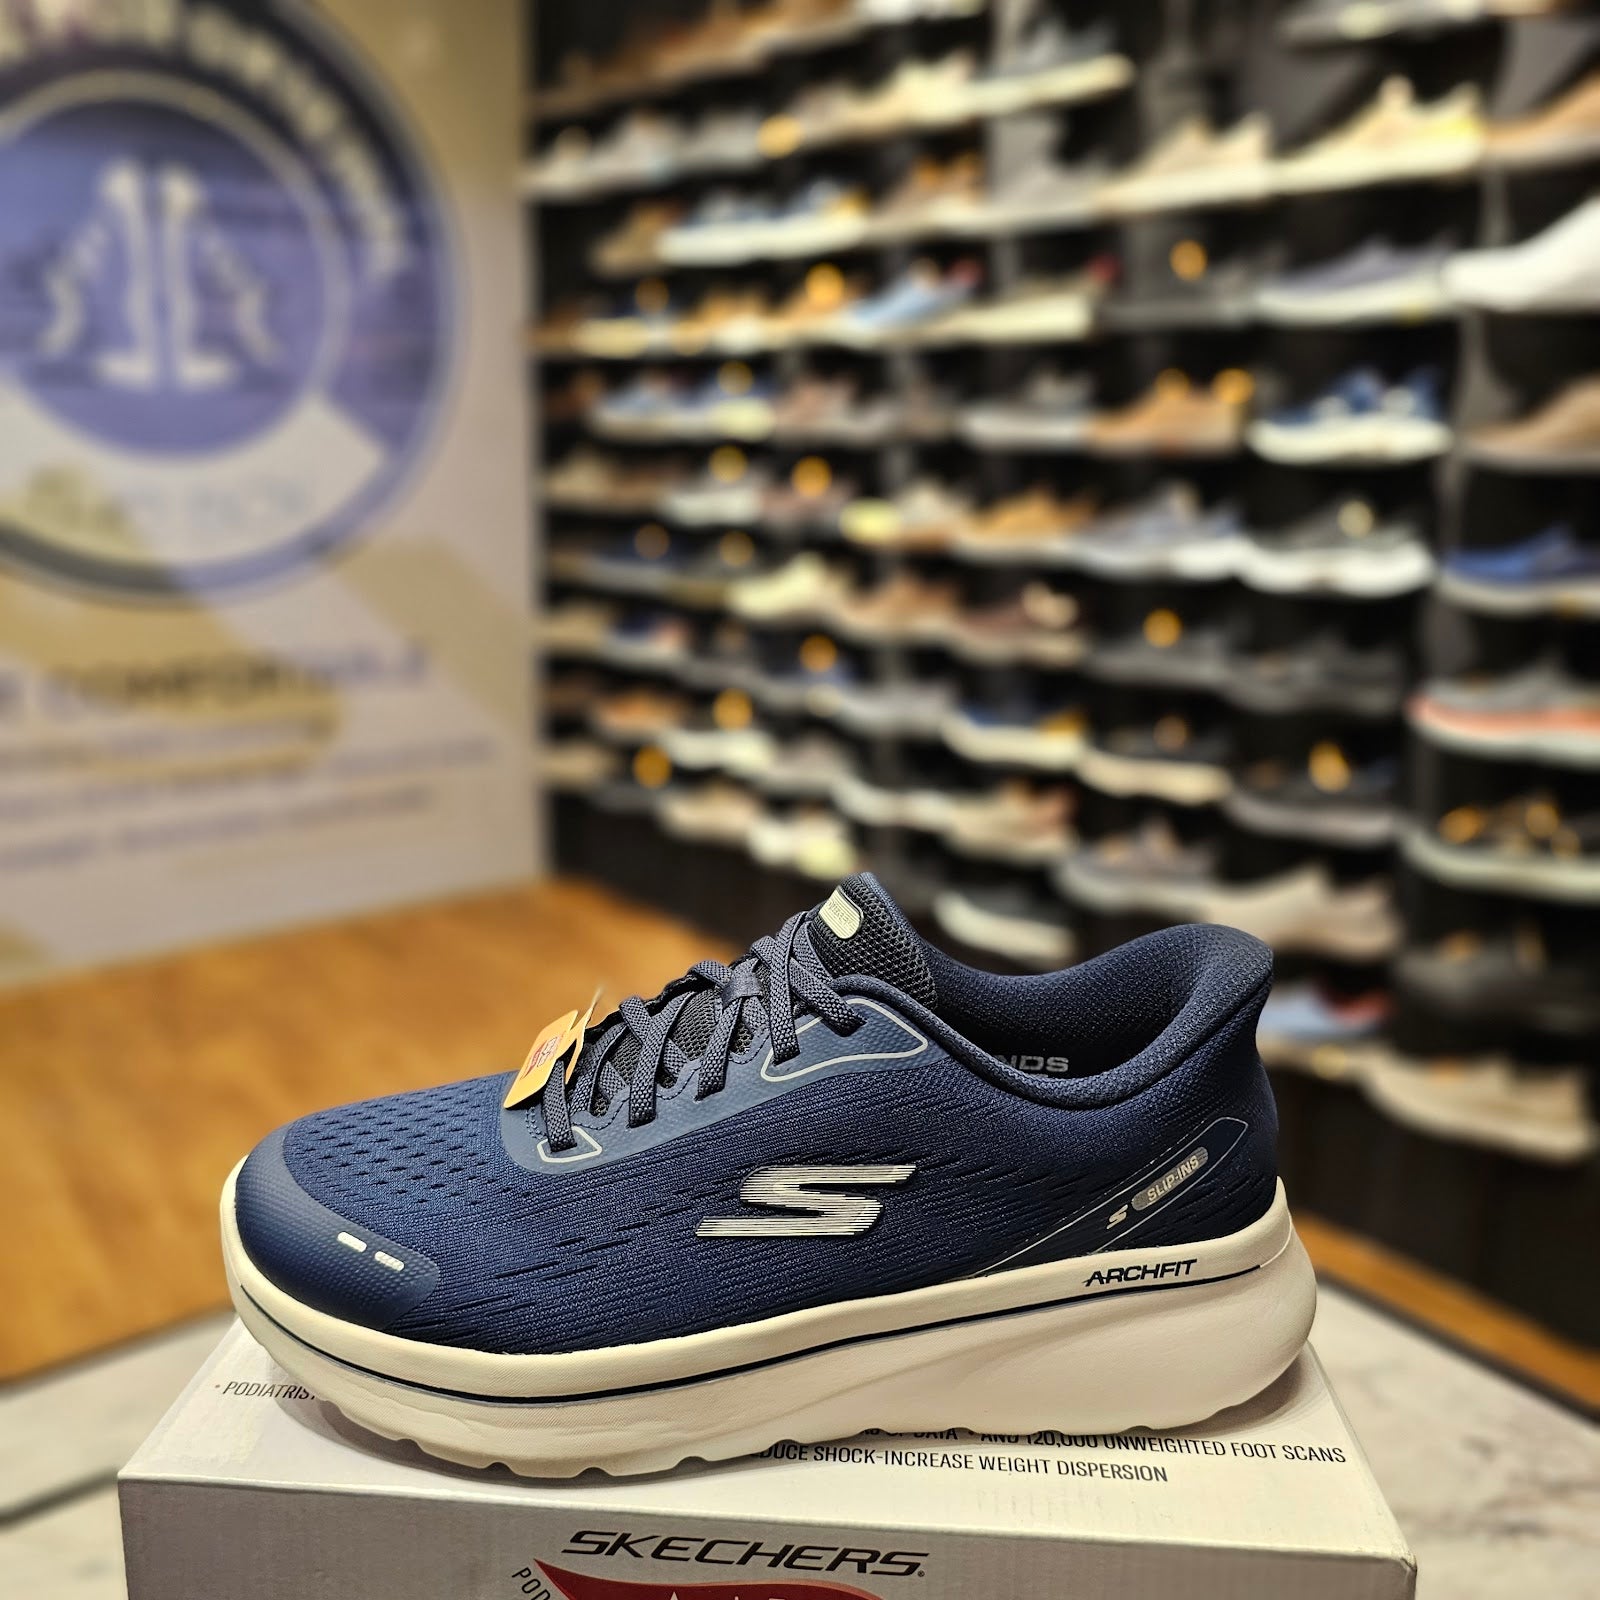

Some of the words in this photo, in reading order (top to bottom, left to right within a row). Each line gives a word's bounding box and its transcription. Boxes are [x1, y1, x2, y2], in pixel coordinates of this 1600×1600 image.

[1147, 1154, 1201, 1203] SLIP-INS
[1081, 1258, 1198, 1287] ARCHFIT
[813, 1445, 975, 1470] SHOCK-INCREASE
[978, 1455, 1051, 1474] WEIGHT
[1057, 1460, 1169, 1482] DISPERSION
[1103, 1435, 1226, 1456] UNWEIGHTED
[1230, 1442, 1278, 1459] FOOT
[1281, 1445, 1347, 1463] SCANS
[561, 1530, 930, 1577] SKECHERS
